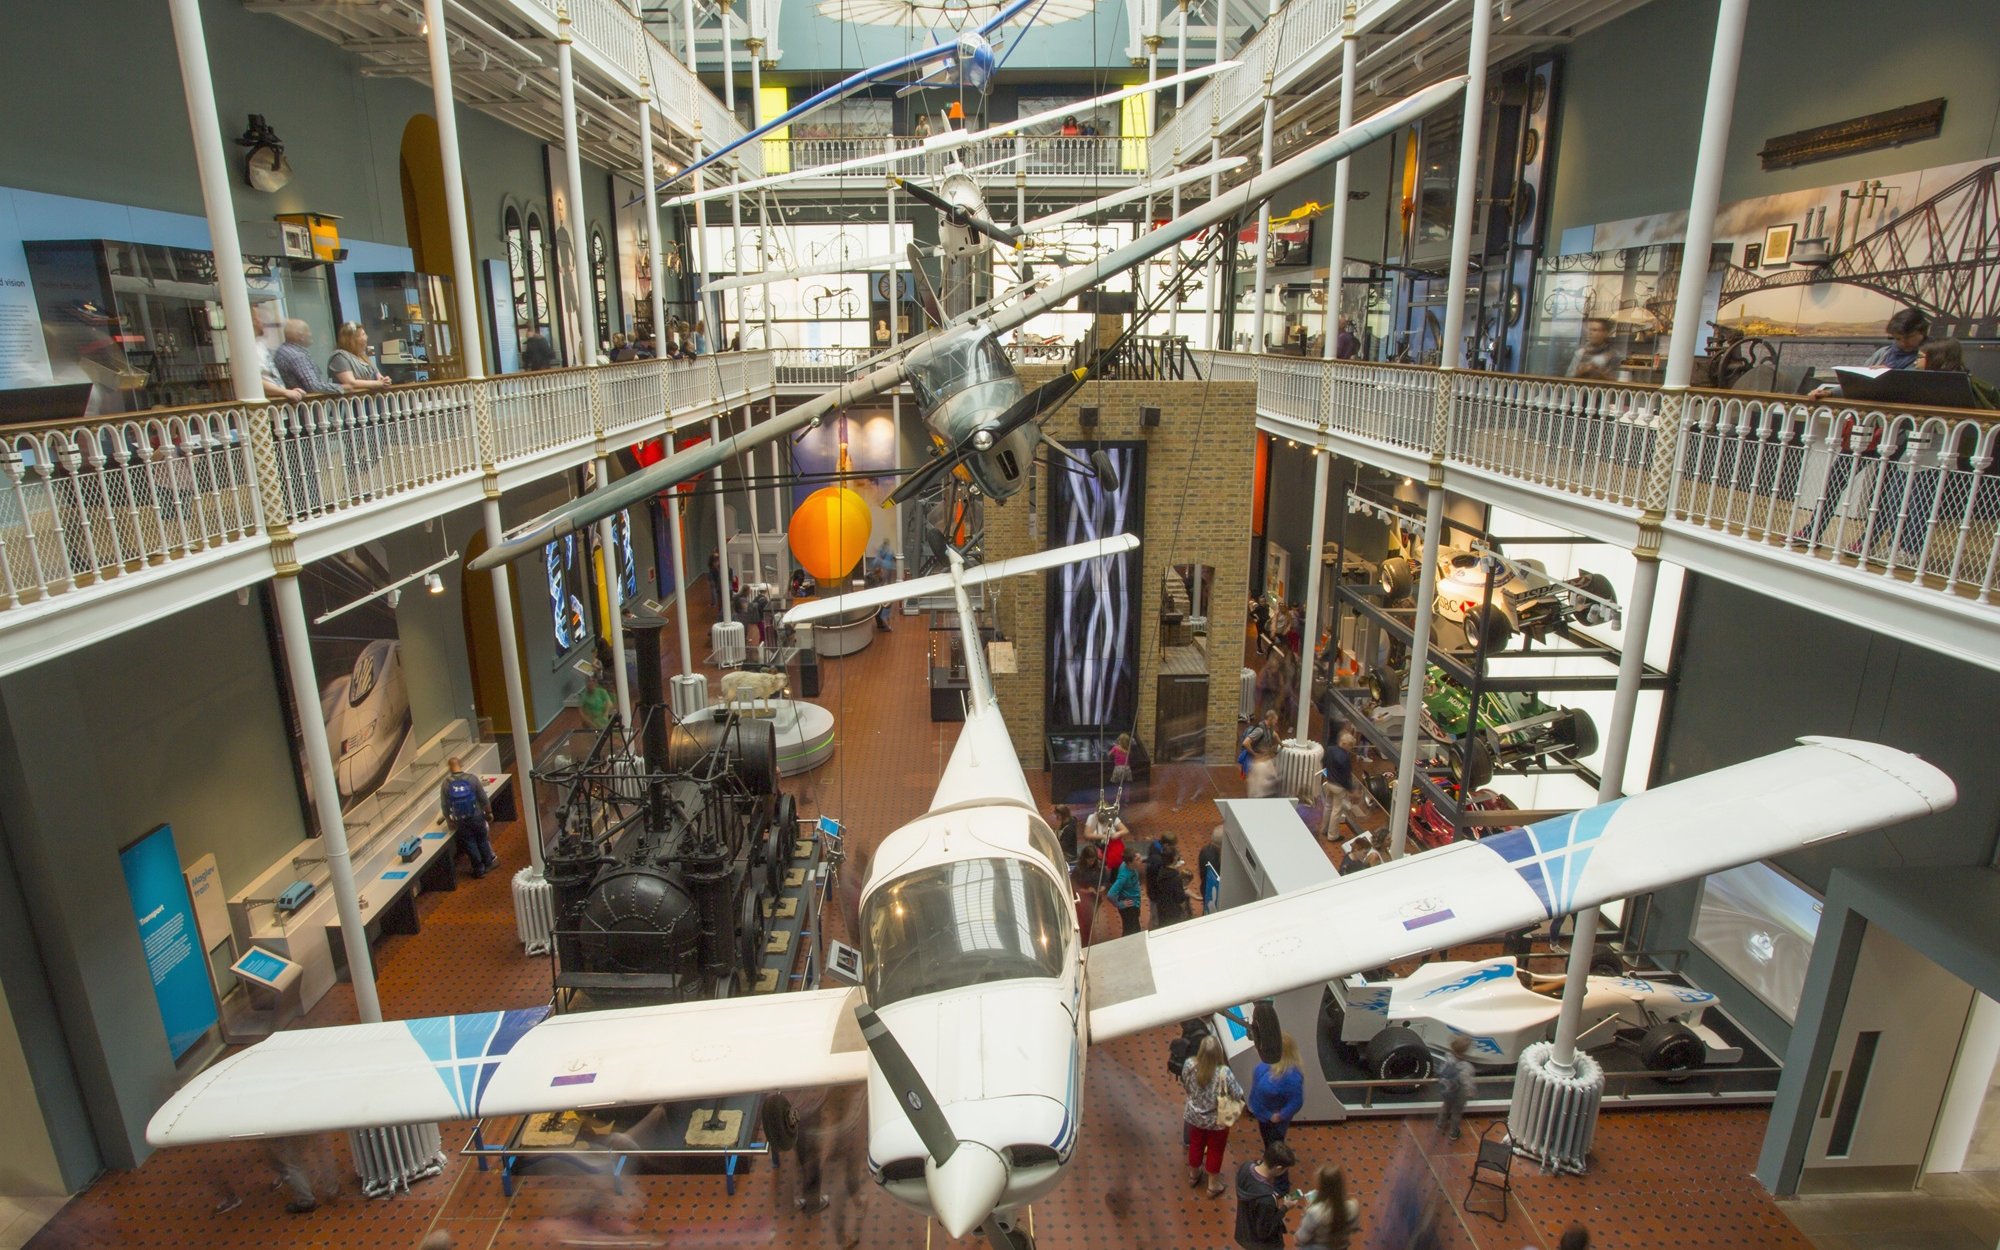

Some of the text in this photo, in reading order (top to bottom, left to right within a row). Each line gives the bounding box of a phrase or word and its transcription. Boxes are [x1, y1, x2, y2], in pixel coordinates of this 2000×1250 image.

[5, 279, 25, 287] vision
[192, 866, 215, 888] Maglev
[194, 883, 210, 898] train
[139, 904, 165, 925] Transport
